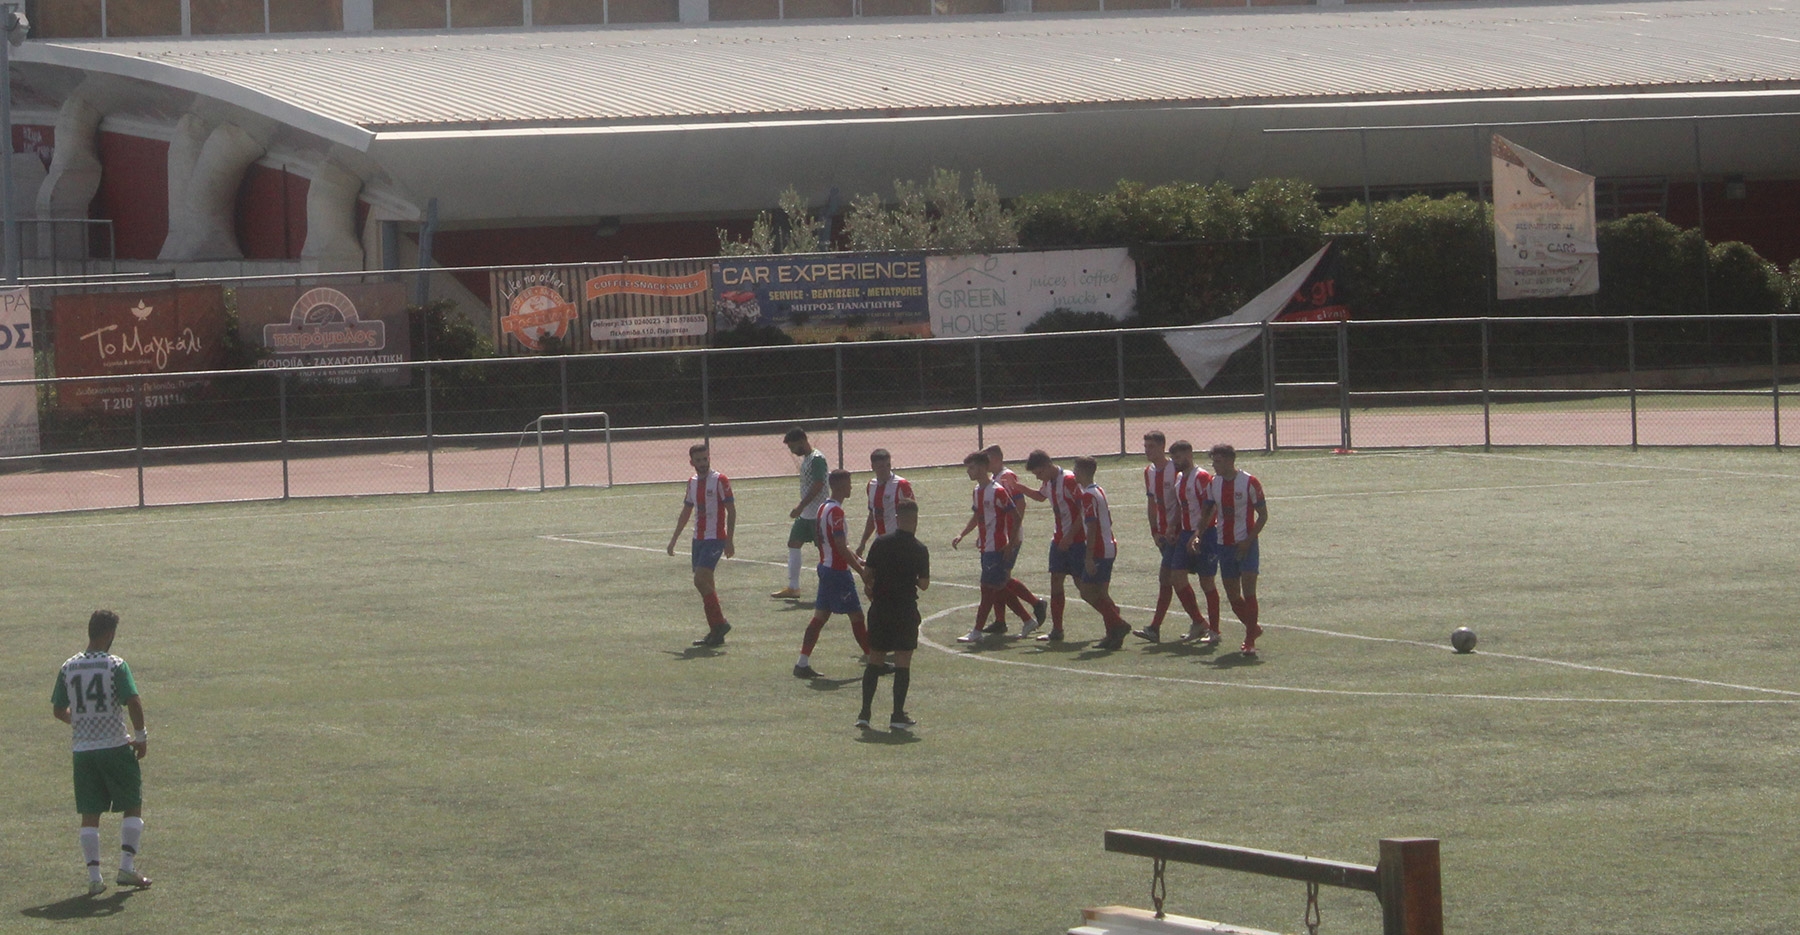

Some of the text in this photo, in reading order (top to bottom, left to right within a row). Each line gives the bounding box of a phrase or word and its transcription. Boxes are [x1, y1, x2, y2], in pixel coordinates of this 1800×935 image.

[1547, 243, 1577, 253] CARS
[722, 261, 922, 285] CAR EXPERIENCE
[1028, 270, 1119, 292] juices coffee
[499, 271, 566, 300] Like no other
[768, 286, 923, 301] SERVICE ΒΕΛΤΙΩΣΕΙΣ ΜΕΤΑΤΡΟΠΕΣ
[790, 300, 903, 312] ΜΗΤΡΟΣ ΠΑΝΑΓΙΩΤΗΣ
[937, 287, 1007, 309] GREEN
[940, 312, 1008, 334] HOUSE
[122, 326, 202, 370] Μαγκάλι
[313, 353, 404, 367] ΖΑΧΑΡΟΠΛΑΣΤΙΚΗ
[113, 398, 133, 410] 210
[70, 672, 107, 714] 14
